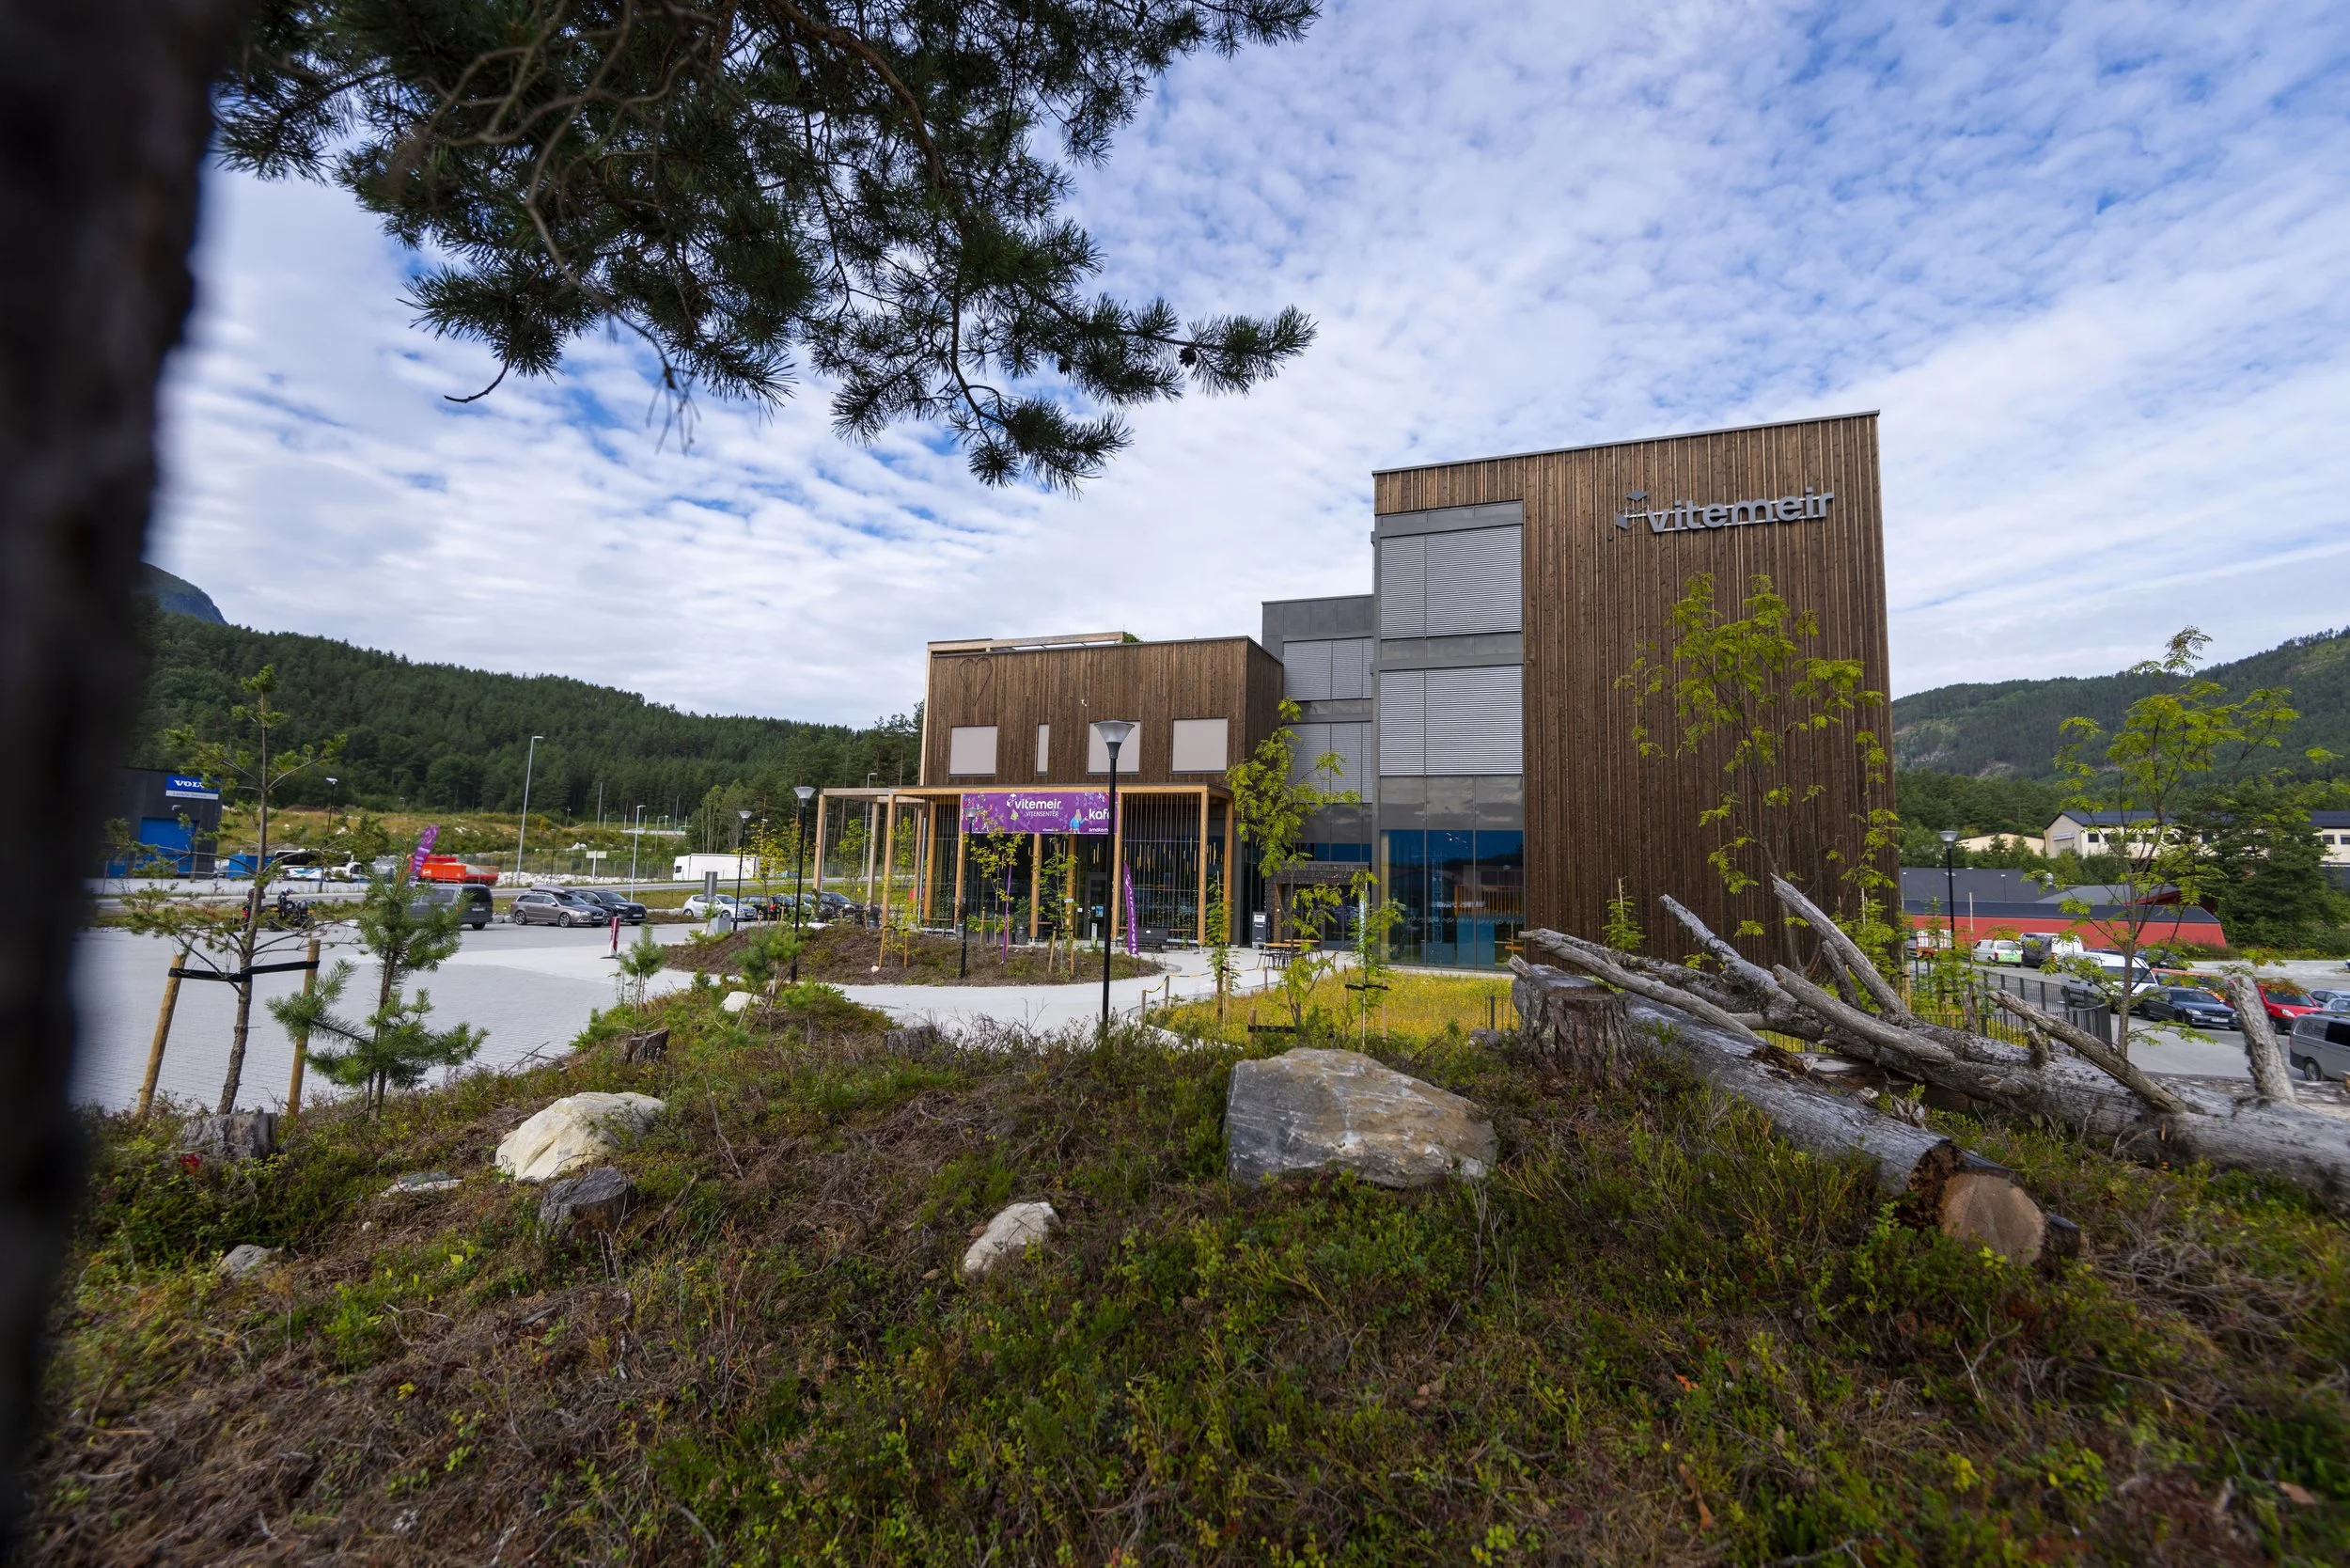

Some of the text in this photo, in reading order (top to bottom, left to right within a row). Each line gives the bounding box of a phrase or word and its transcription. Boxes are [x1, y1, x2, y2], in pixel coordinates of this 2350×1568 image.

[1647, 487, 1834, 533] vitemeir
[174, 779, 205, 788] VOL
[1015, 798, 1061, 808] vitemeir
